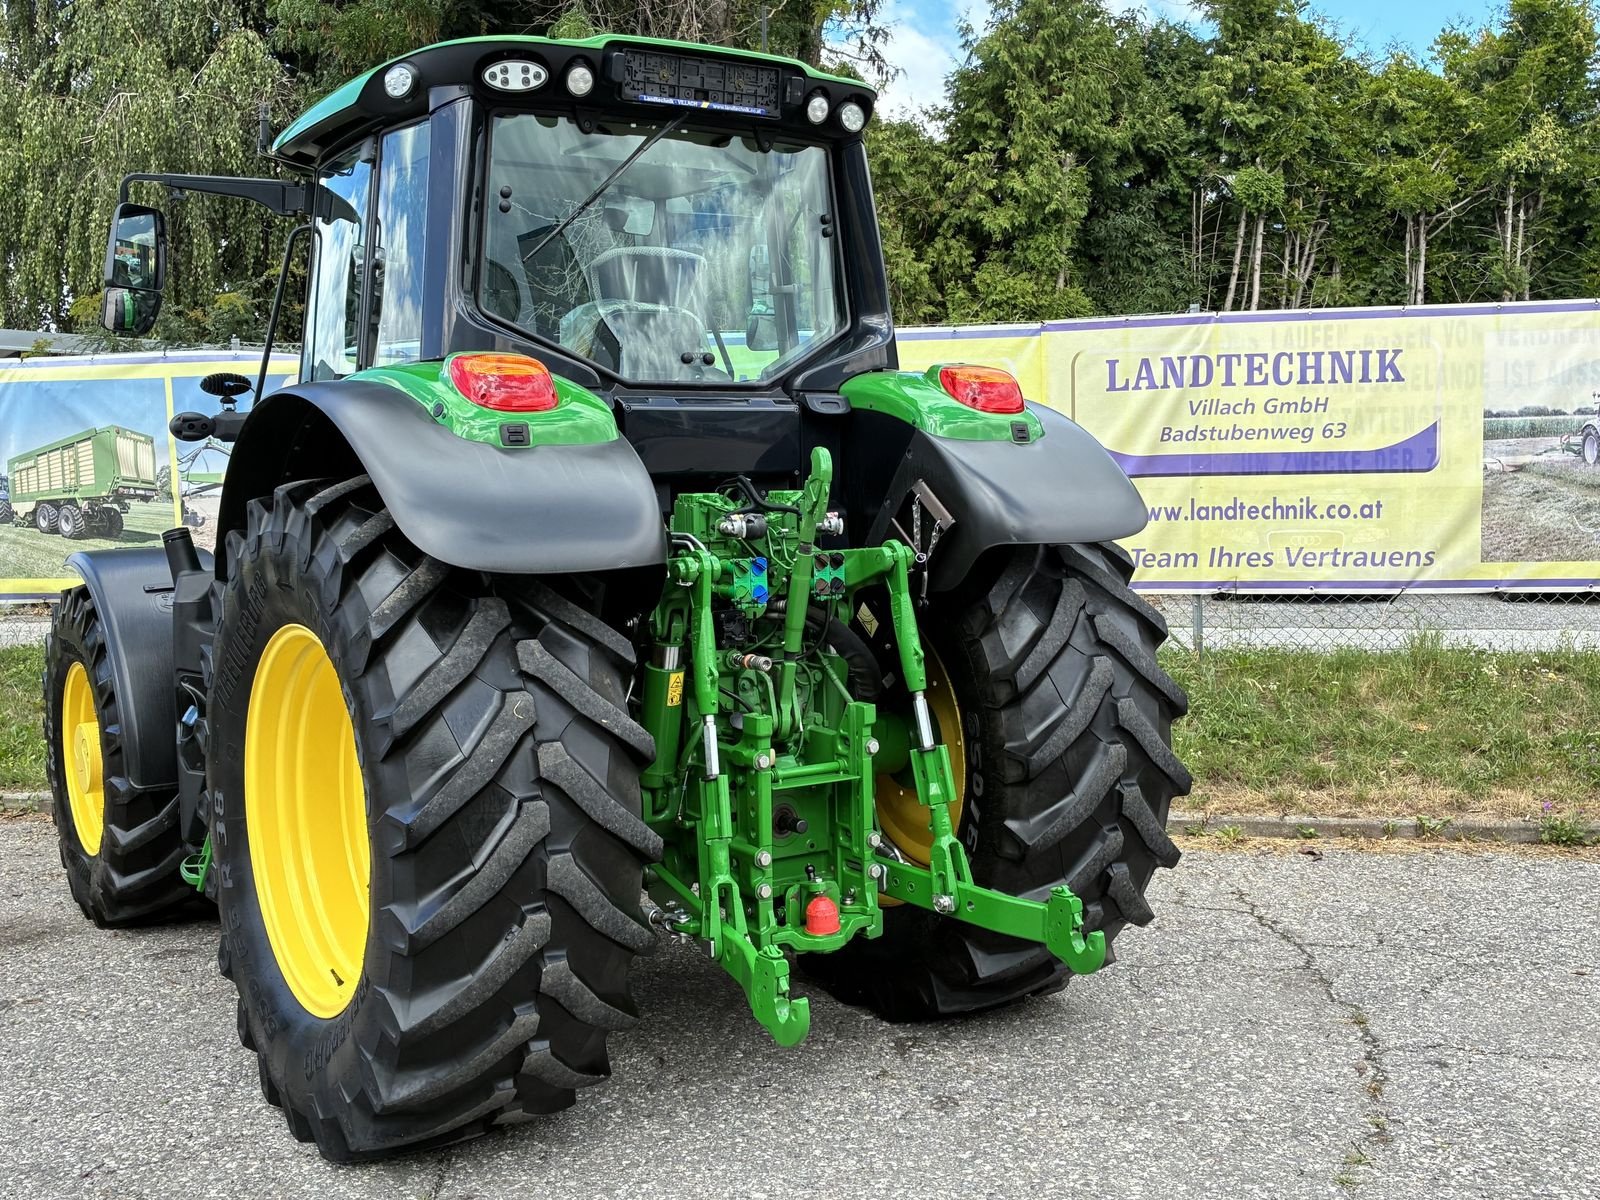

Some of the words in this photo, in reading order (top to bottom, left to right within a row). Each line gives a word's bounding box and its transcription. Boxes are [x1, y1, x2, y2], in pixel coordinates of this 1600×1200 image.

[1105, 349, 1405, 392] LANDTECHNIK
[1189, 399, 1256, 416] Villach
[1264, 397, 1329, 414] GmbH
[1160, 424, 1314, 443] Badstubenweg
[1322, 422, 1347, 439] 63
[1148, 496, 1383, 521] ww.landtechnik.co.at
[1131, 548, 1198, 568] Team
[1209, 546, 1274, 568] Ihres
[1285, 546, 1436, 568] Vertrauens
[213, 788, 229, 847] 38
[220, 863, 233, 889] R
